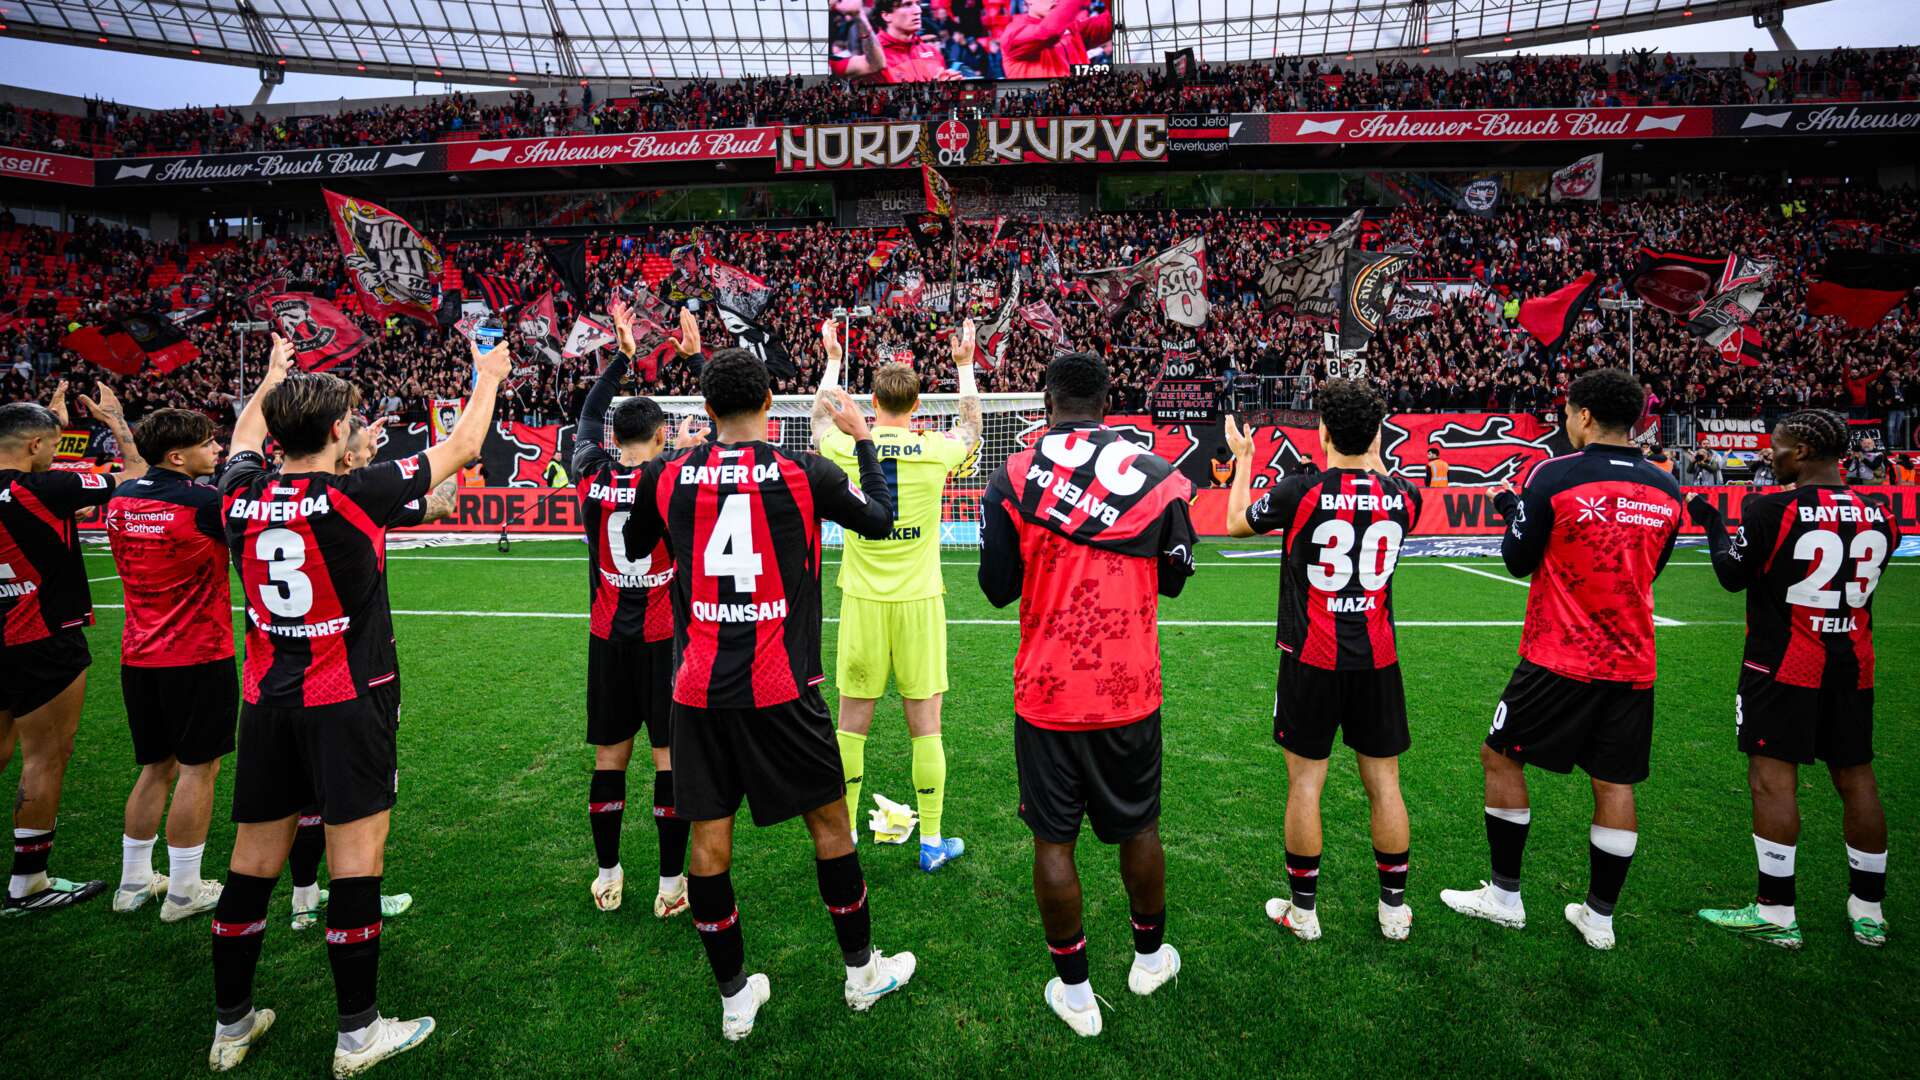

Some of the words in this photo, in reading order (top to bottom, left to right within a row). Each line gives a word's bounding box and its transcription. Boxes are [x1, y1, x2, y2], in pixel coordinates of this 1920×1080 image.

[1349, 113, 1560, 138] Anheuser-Busch
[1565, 113, 1631, 135] Bud
[514, 135, 701, 165] Anheuser-Busch
[705, 133, 765, 156] Bud
[988, 117, 1167, 161] KURVE
[1169, 139, 1229, 151] Leverkusen
[156, 154, 323, 182] Anheuser-Busch
[327, 152, 380, 175] Bud
[938, 147, 967, 165] 04
[1022, 196, 1048, 208] UNS
[1699, 418, 1766, 433] YOUNG
[903, 444, 922, 456] 04
[1705, 434, 1759, 448] BOYS
[680, 465, 748, 484] BAYER
[752, 462, 780, 483] 04
[1026, 463, 1055, 489] 04
[0, 488, 12, 502] 4
[588, 482, 635, 505] BAYER
[1052, 481, 1121, 528] BAYER
[1321, 494, 1379, 511] BAYER
[1381, 494, 1404, 511] 04
[124, 510, 175, 521] Barmenia
[229, 498, 299, 522] BAYER
[300, 493, 330, 517] 04
[1616, 496, 1673, 518] Barmenia
[1798, 505, 1863, 523] BAYER
[1864, 506, 1885, 523] 04
[125, 521, 165, 534] Gothaer
[1615, 510, 1665, 528] Gothaer
[704, 493, 763, 593] 4
[1306, 518, 1404, 593] 30
[255, 527, 314, 618] 3
[1785, 529, 1888, 610] 23
[692, 598, 787, 623] QUANSAH
[1326, 596, 1377, 613] MAZA
[1809, 615, 1858, 633] TELLA
